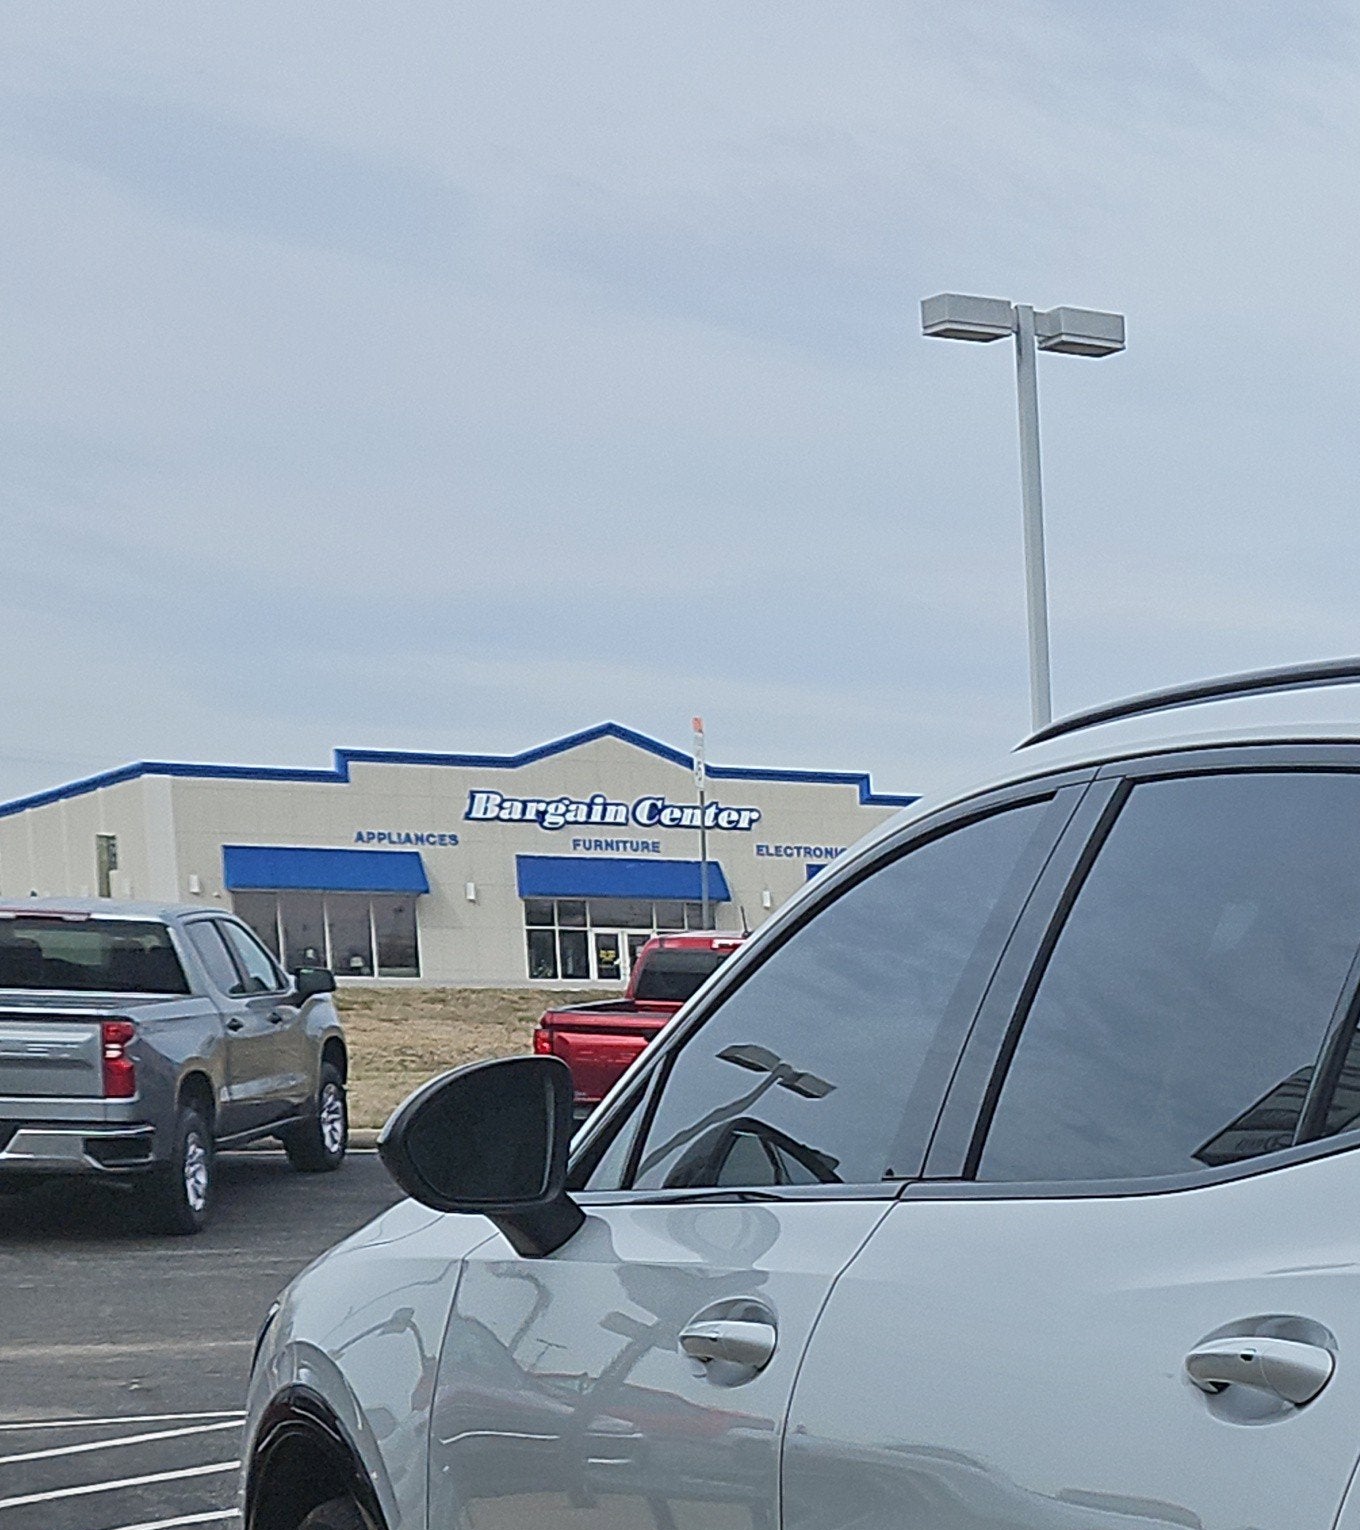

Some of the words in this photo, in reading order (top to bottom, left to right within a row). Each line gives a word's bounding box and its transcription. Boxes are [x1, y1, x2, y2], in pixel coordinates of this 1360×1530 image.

[465, 789, 627, 830] Bargain
[632, 794, 760, 830] Center
[354, 830, 459, 846] APPLIANCES
[572, 838, 661, 853] FURNITURE
